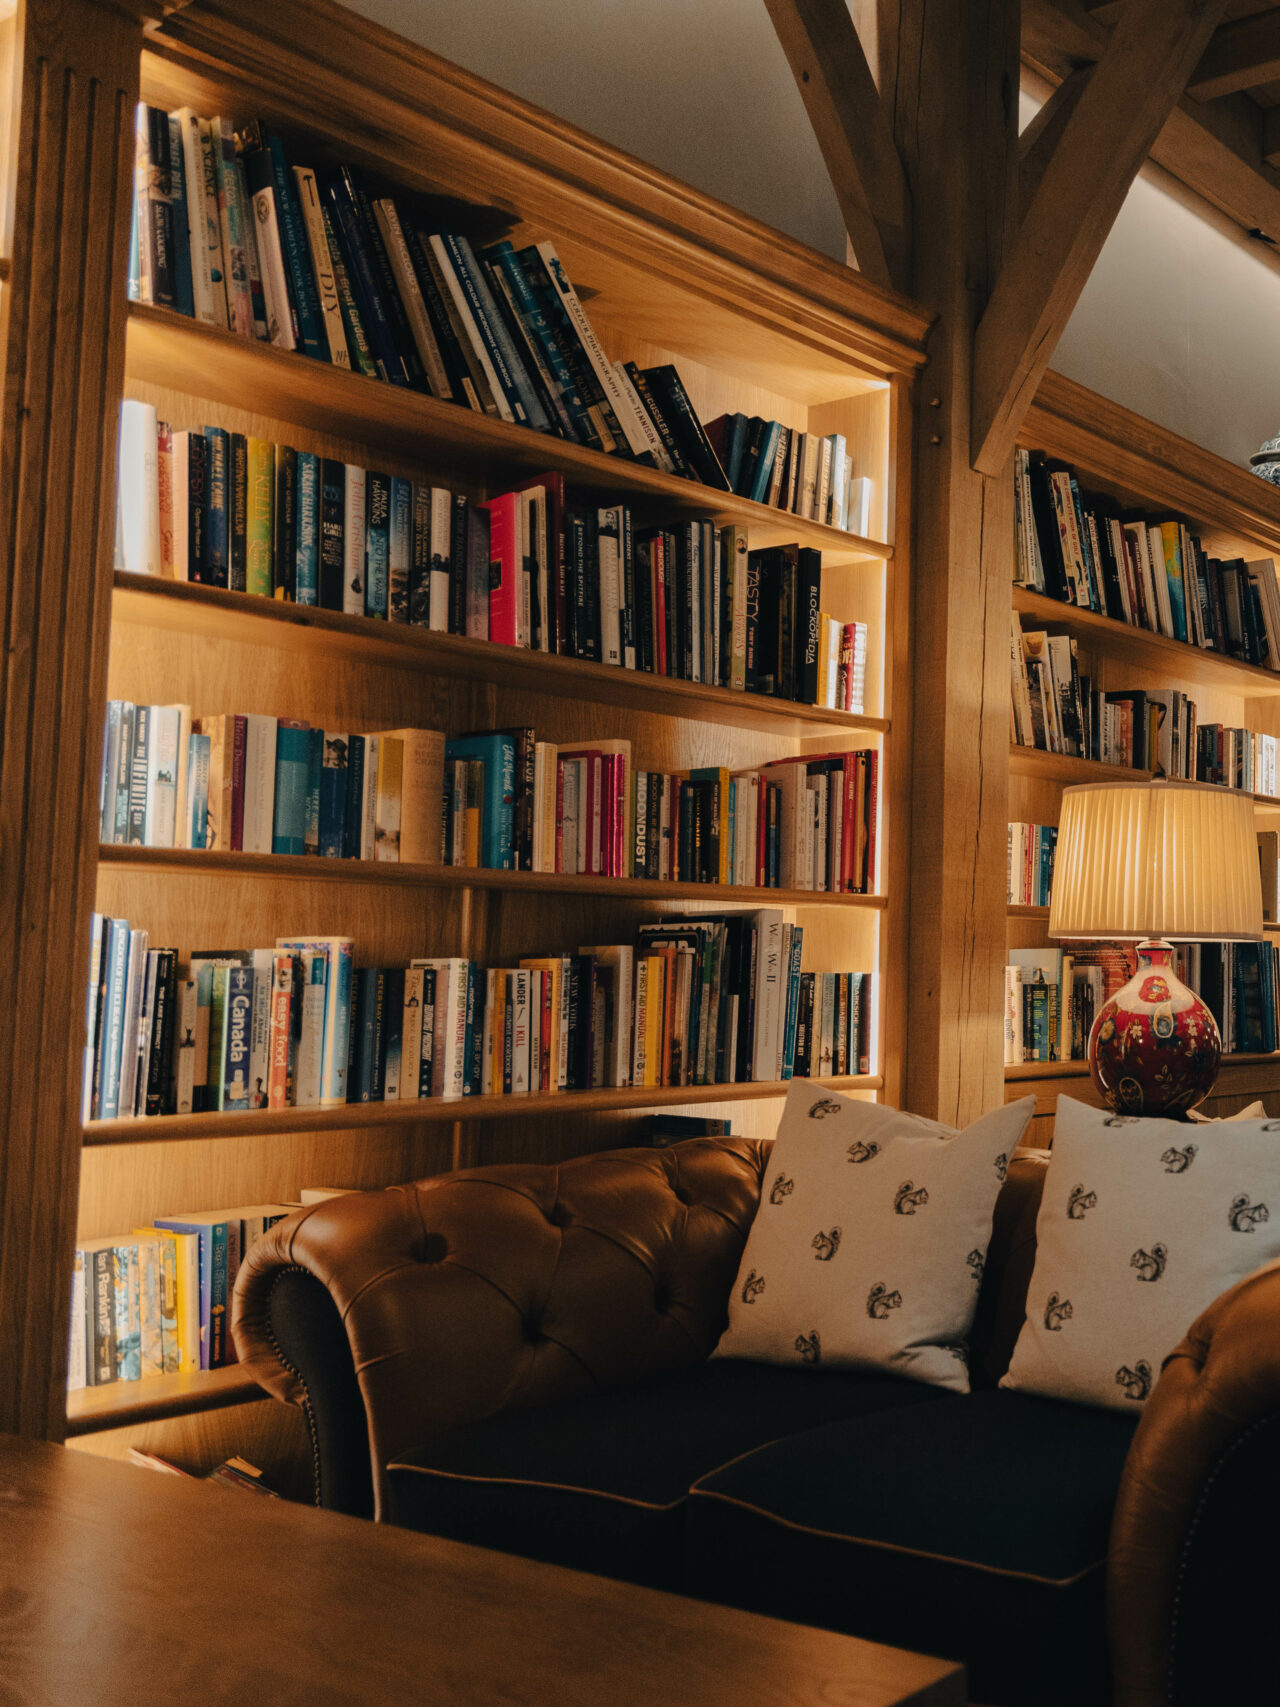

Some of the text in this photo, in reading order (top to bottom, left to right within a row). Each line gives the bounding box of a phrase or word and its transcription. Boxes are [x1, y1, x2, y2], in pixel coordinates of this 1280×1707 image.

[202, 149, 216, 198] SCIENCE
[284, 215, 297, 257] HAMLYN
[386, 204, 402, 235] KEVIN
[292, 260, 303, 288] COOK
[320, 273, 340, 319] DIY
[341, 278, 356, 306] Great
[297, 290, 309, 319] BOOK
[446, 234, 513, 389] HAMLYN ALL COLOUR MICROWAVE COOKBOOK
[348, 309, 368, 352] Gardens
[569, 298, 620, 398] COLOUR PHOTOGRAPHY
[634, 406, 656, 444] TENNISON
[647, 398, 671, 435] CUSSLER
[191, 447, 205, 498] GYPSY
[211, 436, 224, 512] MICHAEL CAINE
[301, 462, 314, 495] SARAH
[255, 474, 269, 525] KELLY
[370, 479, 388, 525] PAULA HAWKINS
[1064, 488, 1072, 516] COMPLETE
[350, 479, 363, 570] John Grisham
[374, 535, 384, 606] INTO THE WATER
[746, 566, 760, 622] TASTY
[805, 585, 818, 665] BLOCKOPEDIA
[525, 729, 535, 784] STATION
[131, 758, 148, 812] INFINITE
[311, 812, 319, 831] AND
[636, 777, 647, 865] MOONDUST
[766, 975, 776, 983] II
[792, 948, 801, 977] COAST
[376, 975, 384, 1001] PETER
[455, 972, 466, 1045] FIRST AID MANUAL
[466, 987, 474, 1024] motorway
[517, 972, 526, 1005] LANDER
[569, 975, 579, 1032] NEW YORK
[637, 973, 647, 1040] FIRST AID MANUAL
[852, 982, 860, 1025] DARKSIDE
[230, 995, 250, 1062] Canada
[257, 1018, 265, 1043] Abroad
[272, 996, 289, 1066] easy food
[504, 1004, 512, 1074] student cookbook
[516, 1030, 525, 1048] KILL
[97, 1252, 111, 1319] Ian Rankin
